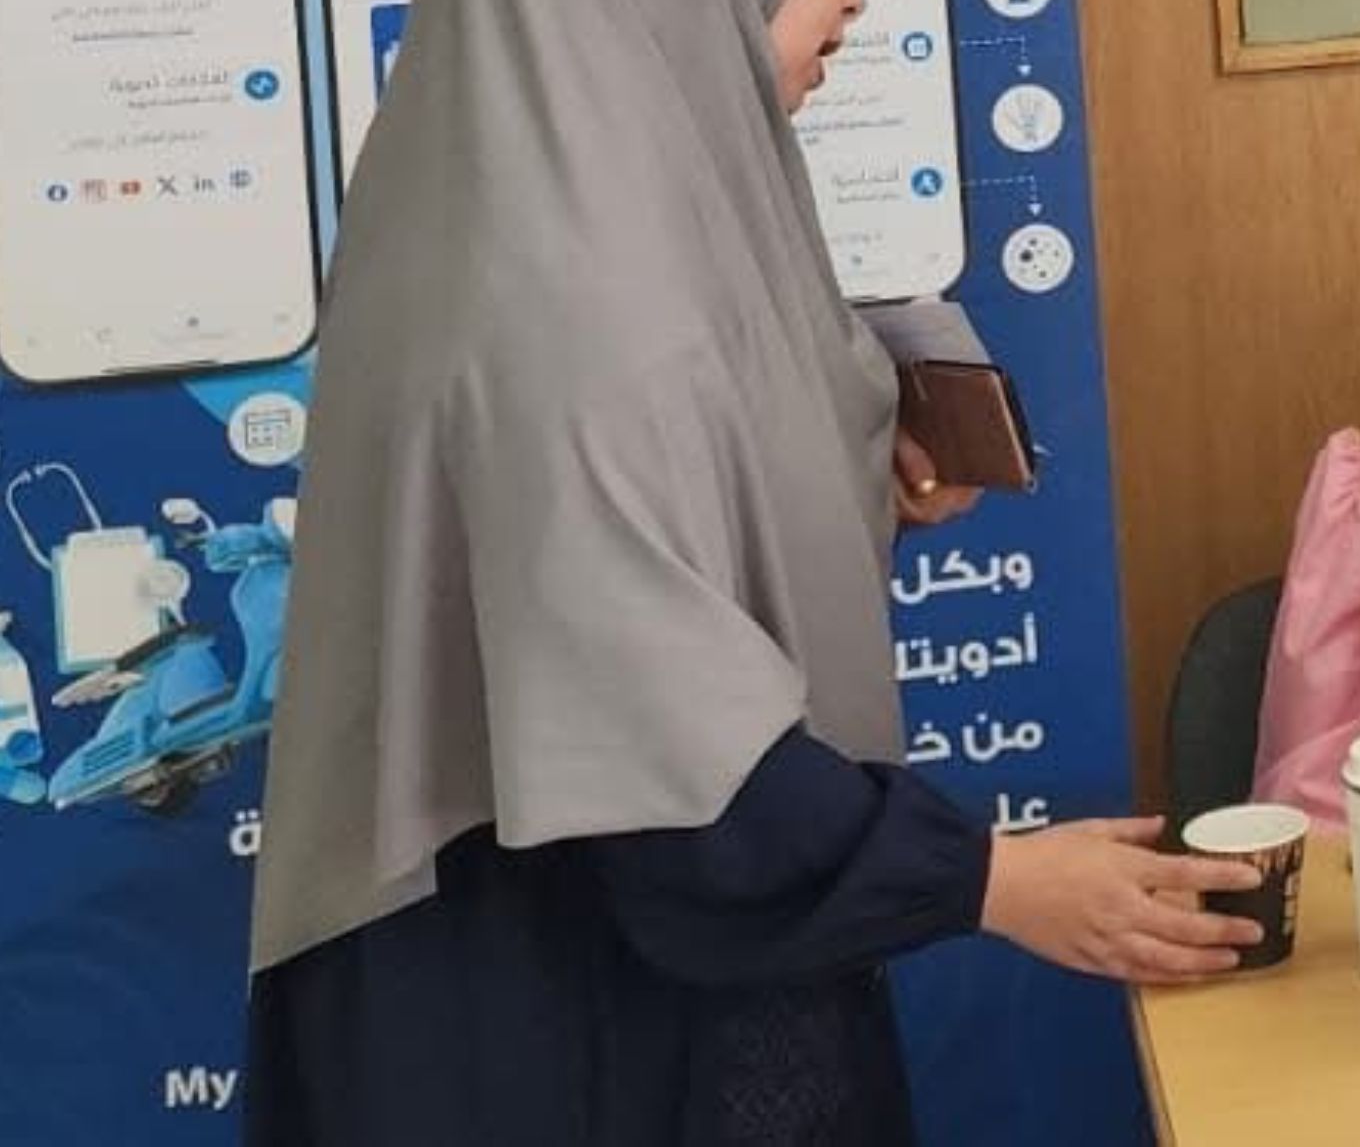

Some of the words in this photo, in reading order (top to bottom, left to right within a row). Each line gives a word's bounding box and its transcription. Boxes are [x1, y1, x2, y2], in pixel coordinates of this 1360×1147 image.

[890, 549, 1035, 604] وبكل
[962, 712, 1044, 763] من
[164, 1065, 238, 1110] My
